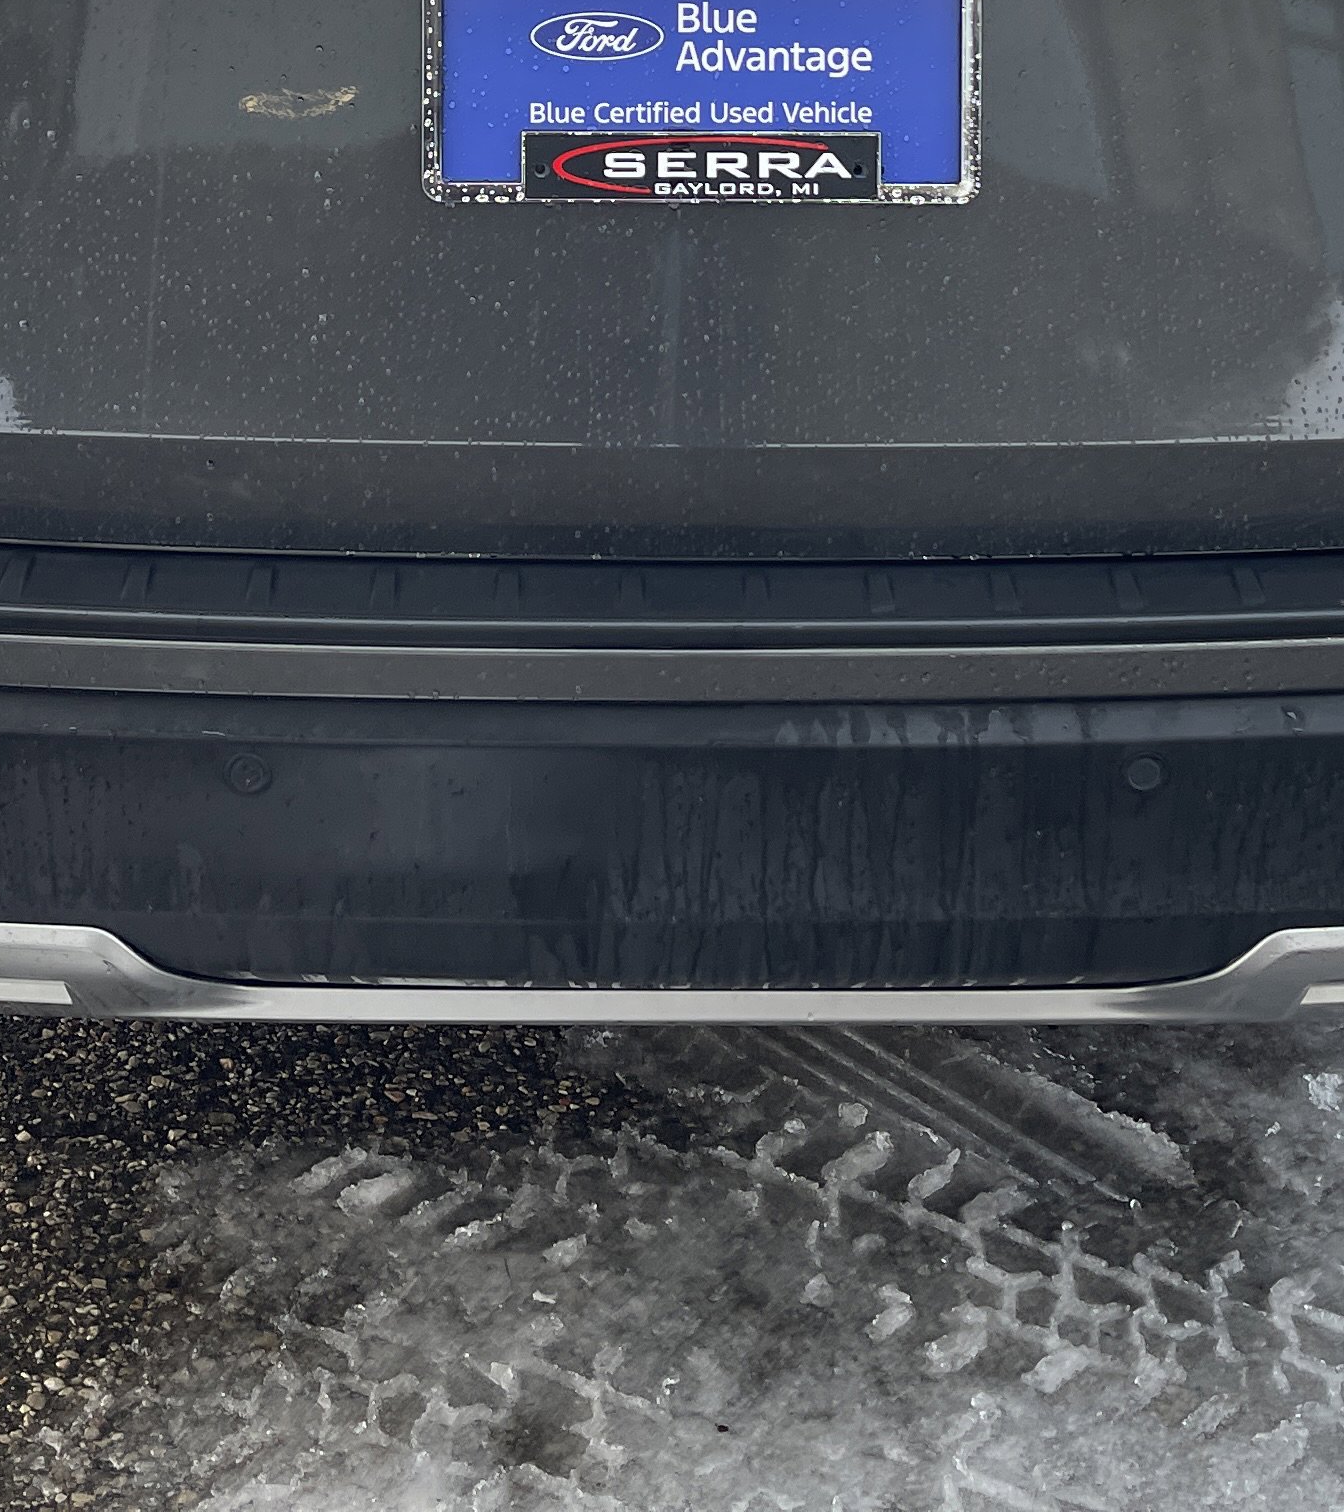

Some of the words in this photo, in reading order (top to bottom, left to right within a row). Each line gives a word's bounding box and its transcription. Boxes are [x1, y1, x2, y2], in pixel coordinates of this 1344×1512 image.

[676, 1, 757, 34] Blue
[556, 18, 639, 53] Ford
[675, 39, 873, 78] Advantage
[529, 101, 586, 124] Blue
[593, 101, 701, 124] Certified
[710, 101, 774, 124] Used
[782, 101, 873, 124] Vehicle
[602, 151, 852, 179] SERRA
[654, 182, 782, 196] GAYLORD,
[792, 182, 819, 196] MI
